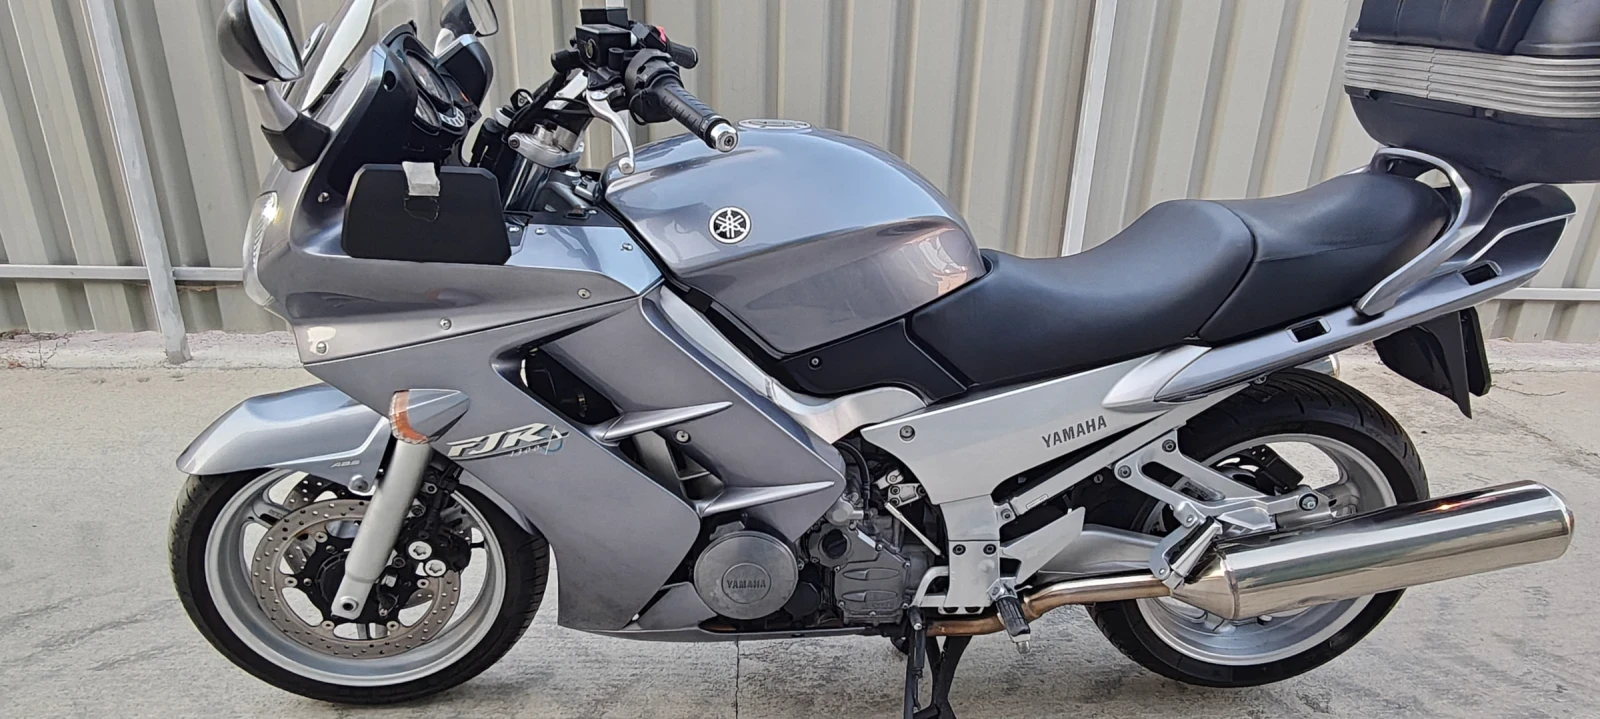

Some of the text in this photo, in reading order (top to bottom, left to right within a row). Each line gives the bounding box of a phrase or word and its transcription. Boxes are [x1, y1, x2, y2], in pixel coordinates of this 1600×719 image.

[446, 422, 550, 457] FJR
[1041, 415, 1107, 448] YAMAHA
[726, 579, 767, 589] YAMAHA
